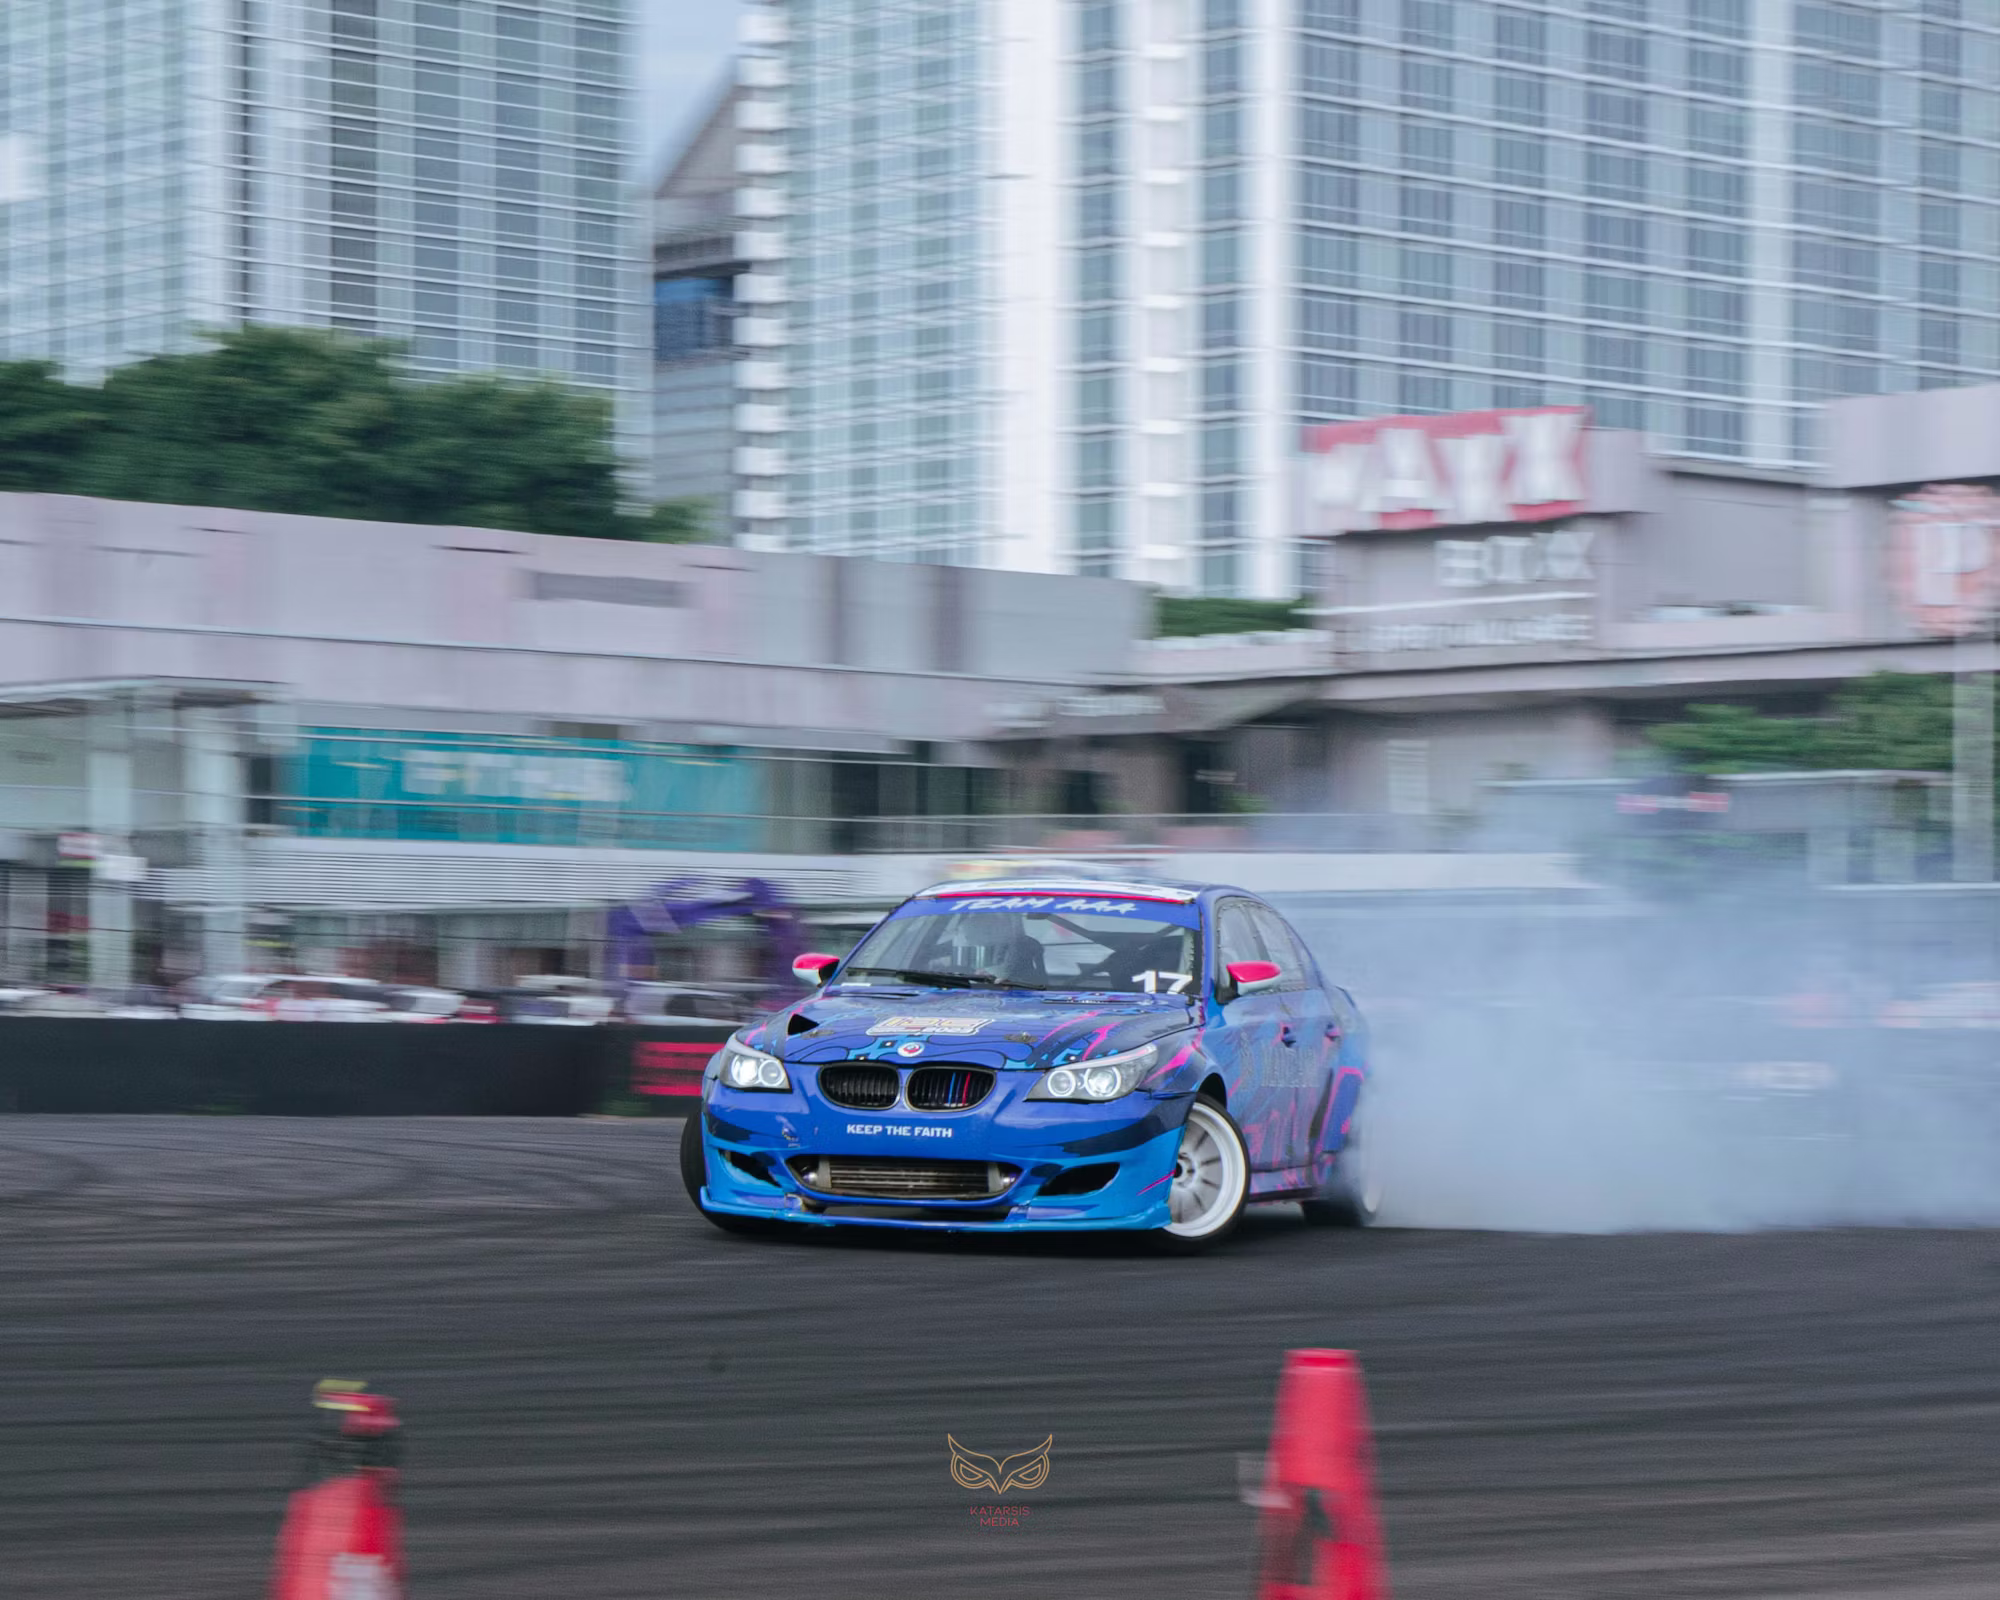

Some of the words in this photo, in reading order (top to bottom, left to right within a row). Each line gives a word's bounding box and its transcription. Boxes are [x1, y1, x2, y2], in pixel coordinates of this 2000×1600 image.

[950, 896, 1055, 911] TEAM
[1131, 969, 1194, 995] 17
[846, 1123, 883, 1135] KEEP
[885, 1125, 912, 1137] THE
[914, 1126, 953, 1138] FAITH
